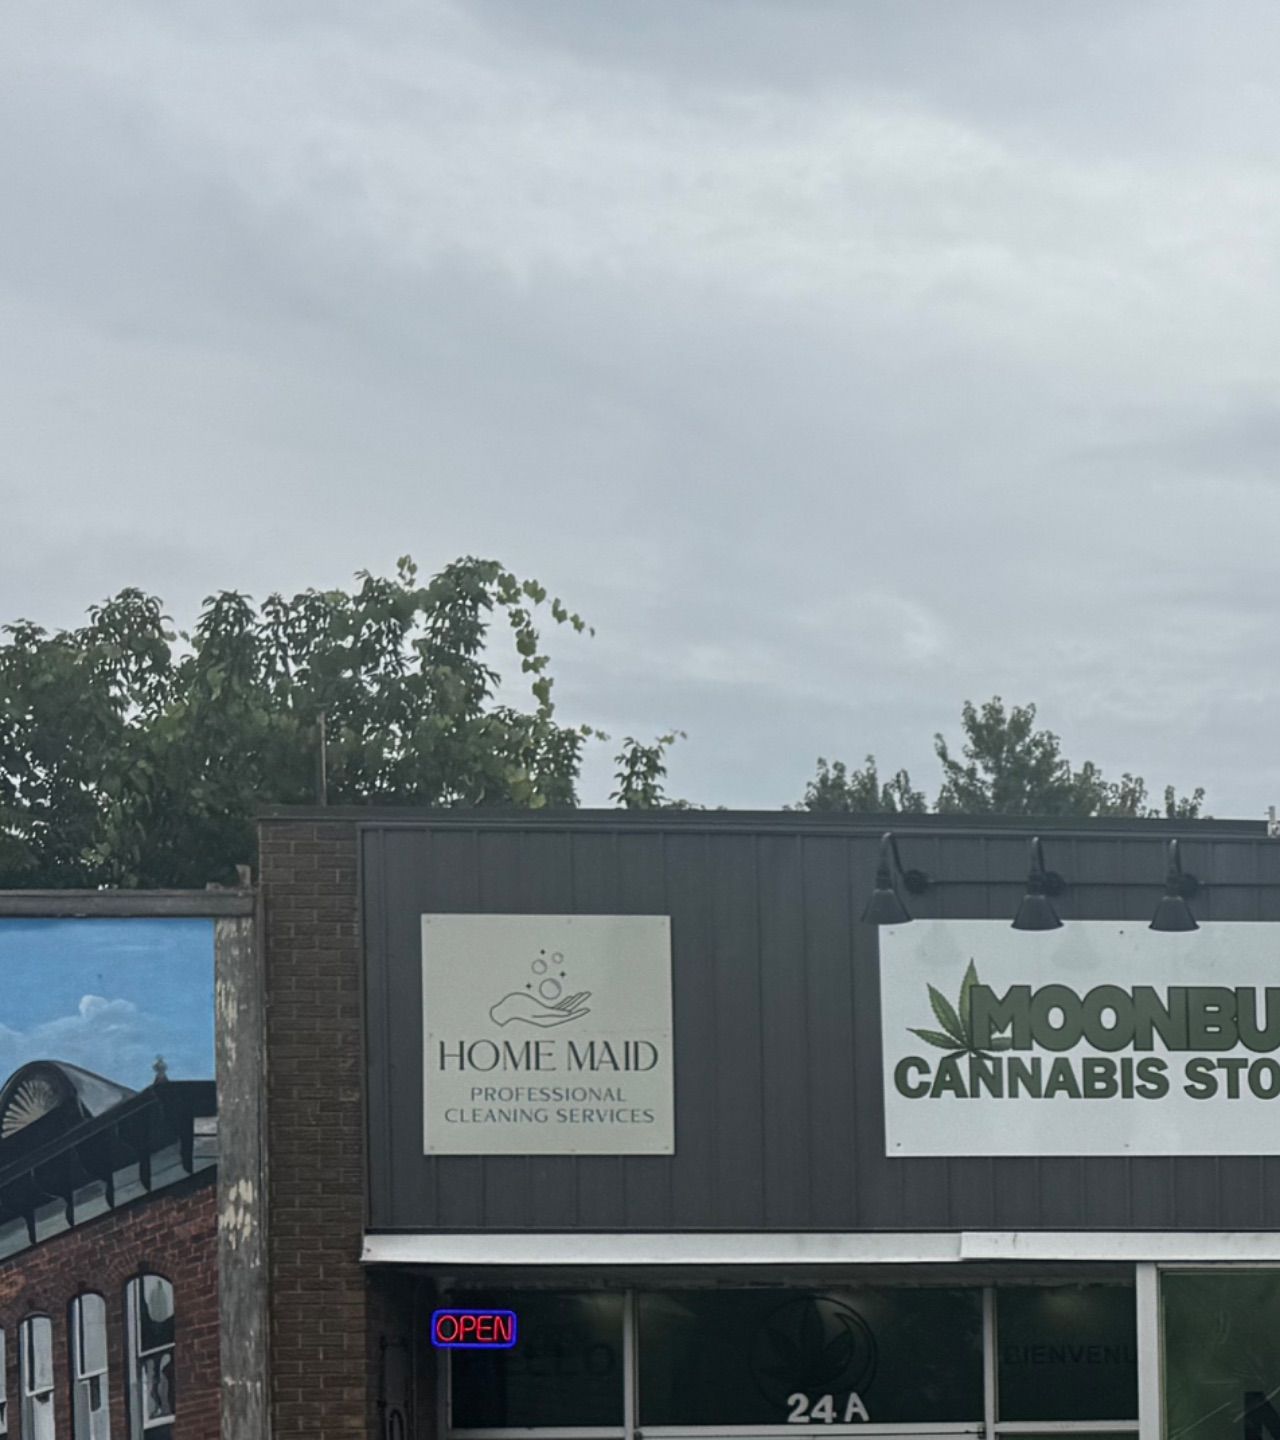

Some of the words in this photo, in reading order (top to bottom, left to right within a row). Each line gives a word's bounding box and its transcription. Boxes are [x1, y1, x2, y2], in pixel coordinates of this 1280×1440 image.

[439, 1040, 556, 1073] HOME
[566, 1039, 659, 1072] MAID
[894, 1057, 1169, 1100] CANNABIS
[470, 1086, 627, 1102] PROFESSIONAL
[444, 1108, 549, 1124] CLEANING
[556, 1108, 655, 1124] SERVICES
[436, 1315, 513, 1342] OPEN
